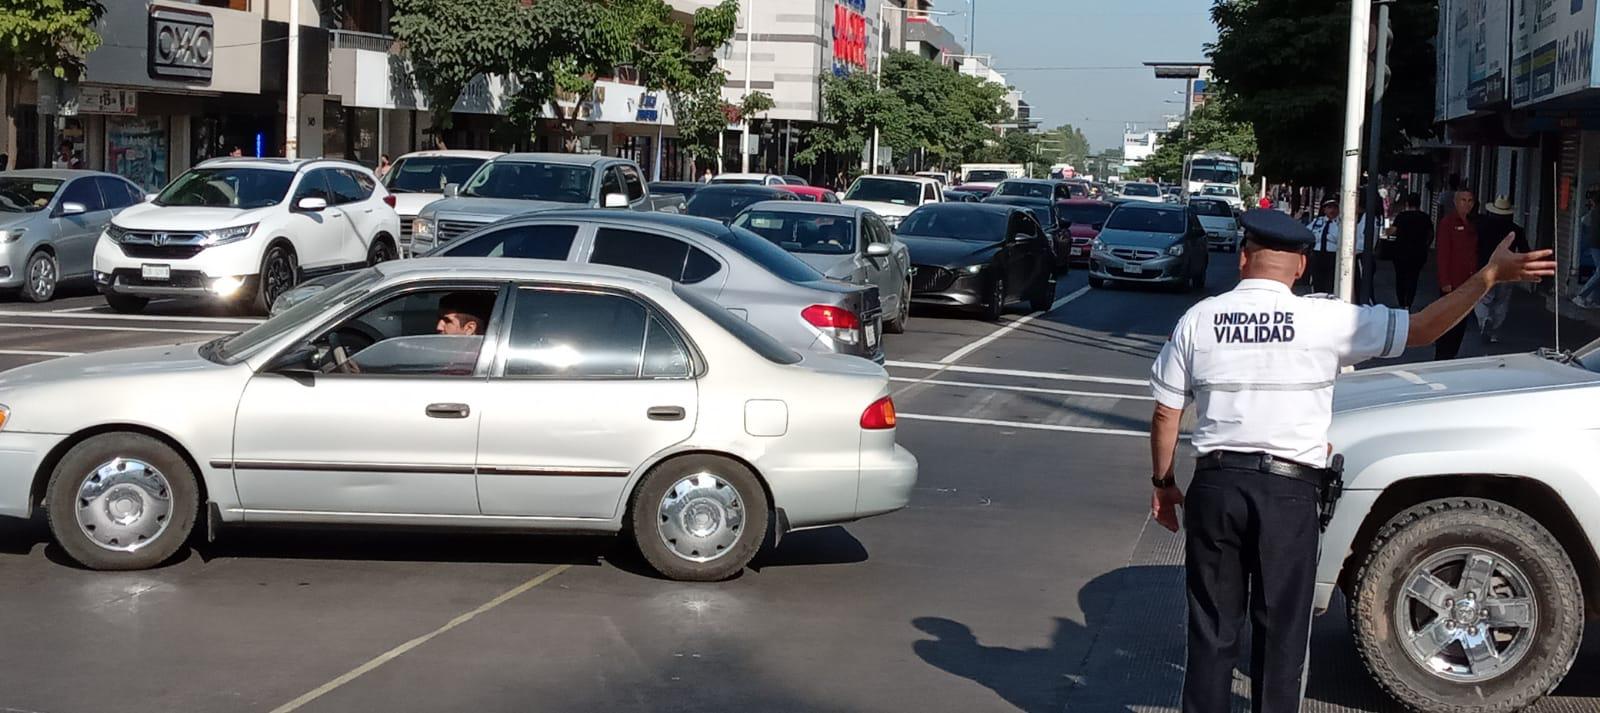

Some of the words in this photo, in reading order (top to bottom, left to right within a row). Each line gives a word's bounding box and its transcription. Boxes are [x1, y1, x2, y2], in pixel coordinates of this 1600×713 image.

[157, 24, 212, 66] OXXO
[1213, 312, 1270, 326] UNIDAD
[1273, 311, 1294, 325] DE
[1213, 325, 1295, 344] VIALIDAD
